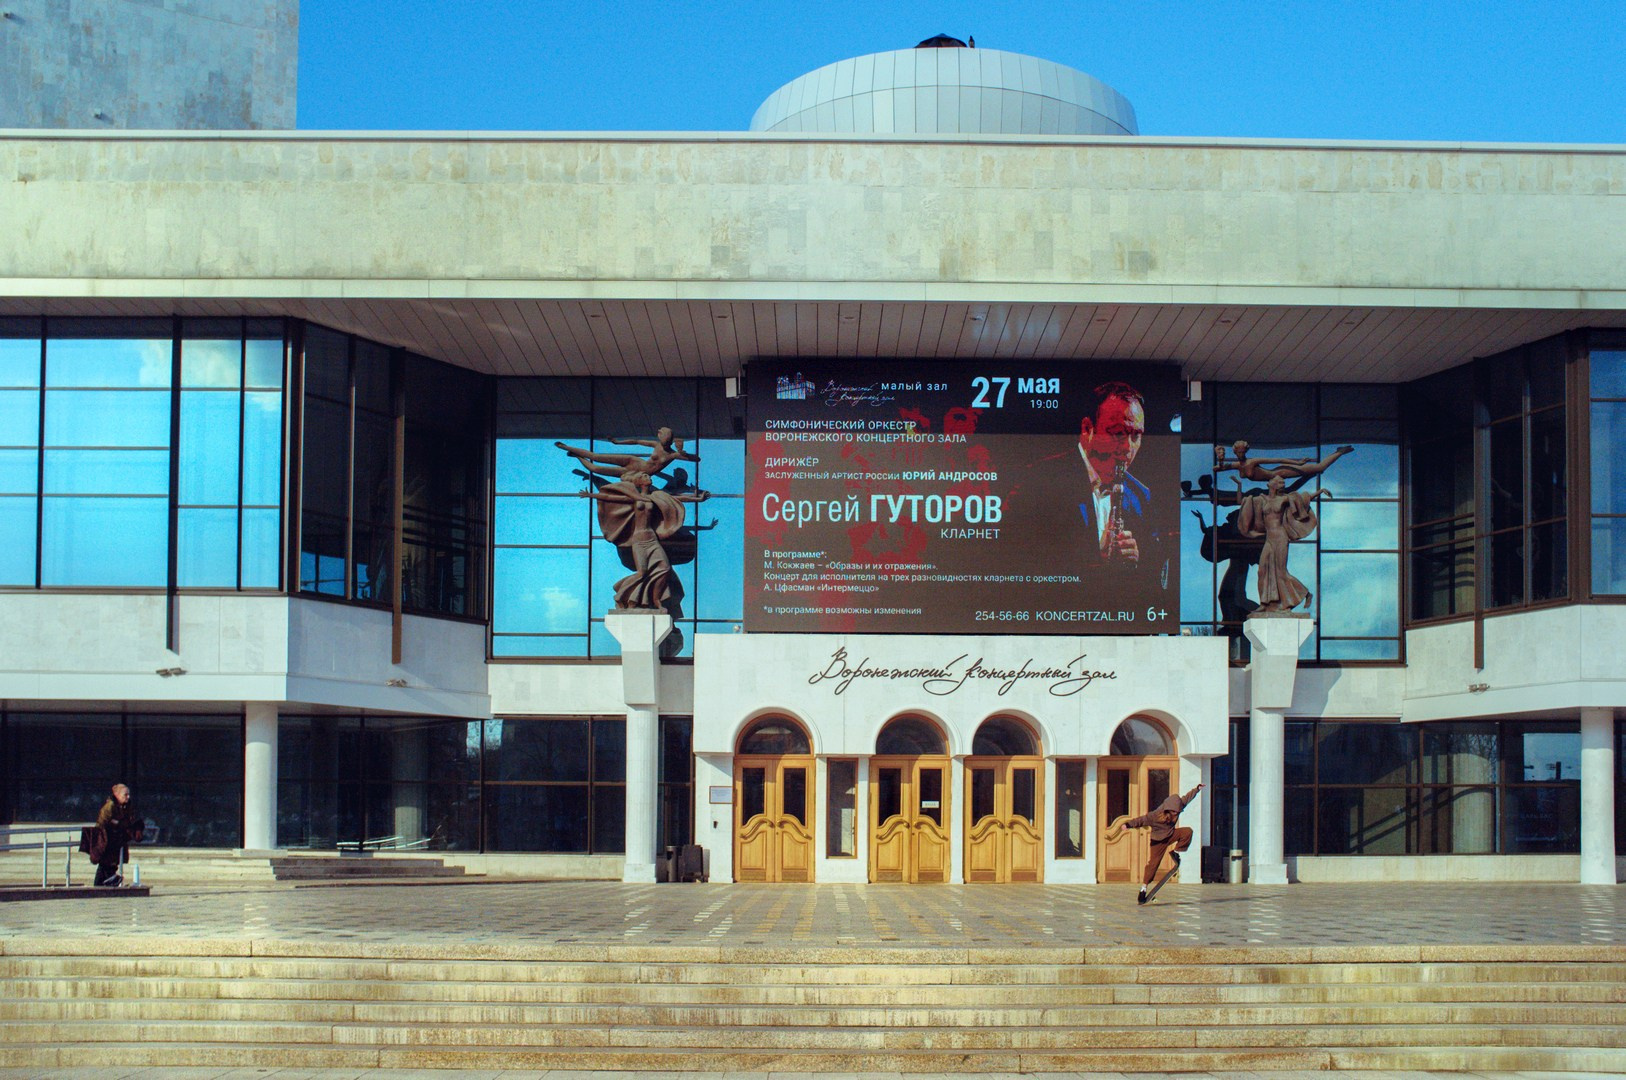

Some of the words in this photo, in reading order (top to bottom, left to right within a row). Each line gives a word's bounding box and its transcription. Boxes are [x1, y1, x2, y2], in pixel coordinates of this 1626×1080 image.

[881, 382, 922, 391] малый
[926, 383, 948, 391] зал
[971, 377, 1011, 408] 27
[1017, 378, 1060, 395] мая
[1030, 400, 1059, 409] 19:00
[765, 419, 865, 430] СИМФОНИЧЕСКИЙ
[868, 420, 917, 430] ОРКЕСТР
[765, 433, 853, 442] ВОРОНЕЖСКОГО
[856, 433, 935, 444] КОНЦЕРТНОГО
[938, 434, 967, 443] ЗАЛА
[765, 456, 820, 468] ДИРИЖЁР
[765, 471, 829, 480] ЗАСЛУЖЕННЫЙ
[831, 472, 864, 480] АРТИСТ
[902, 469, 935, 481] ЮРИЙ
[938, 471, 998, 482] АНДРОСОВ
[762, 493, 860, 528] Сергей
[870, 494, 1003, 523] ГУТОРОВ
[941, 528, 1000, 539] КЛАРНЕТ
[764, 550, 771, 558] В
[825, 562, 863, 571] «Образы
[764, 573, 800, 581] Концерт
[802, 574, 818, 582] для
[911, 575, 982, 583] разновидностях
[984, 575, 1024, 583] кларнета
[1033, 575, 1082, 584] оркестром.
[764, 584, 772, 592] А.
[774, 584, 815, 593] Цфасман
[817, 584, 880, 593] «Интермеццо»
[775, 607, 824, 616] программе
[825, 607, 872, 615] возможны
[874, 607, 922, 615] изменения
[975, 611, 1030, 621] 254-56-66
[1036, 611, 1135, 621] KONCERTZAL.RU
[1147, 606, 1169, 621] 6+
[808, 646, 968, 696] Воронежский
[1049, 669, 1118, 697] зал
